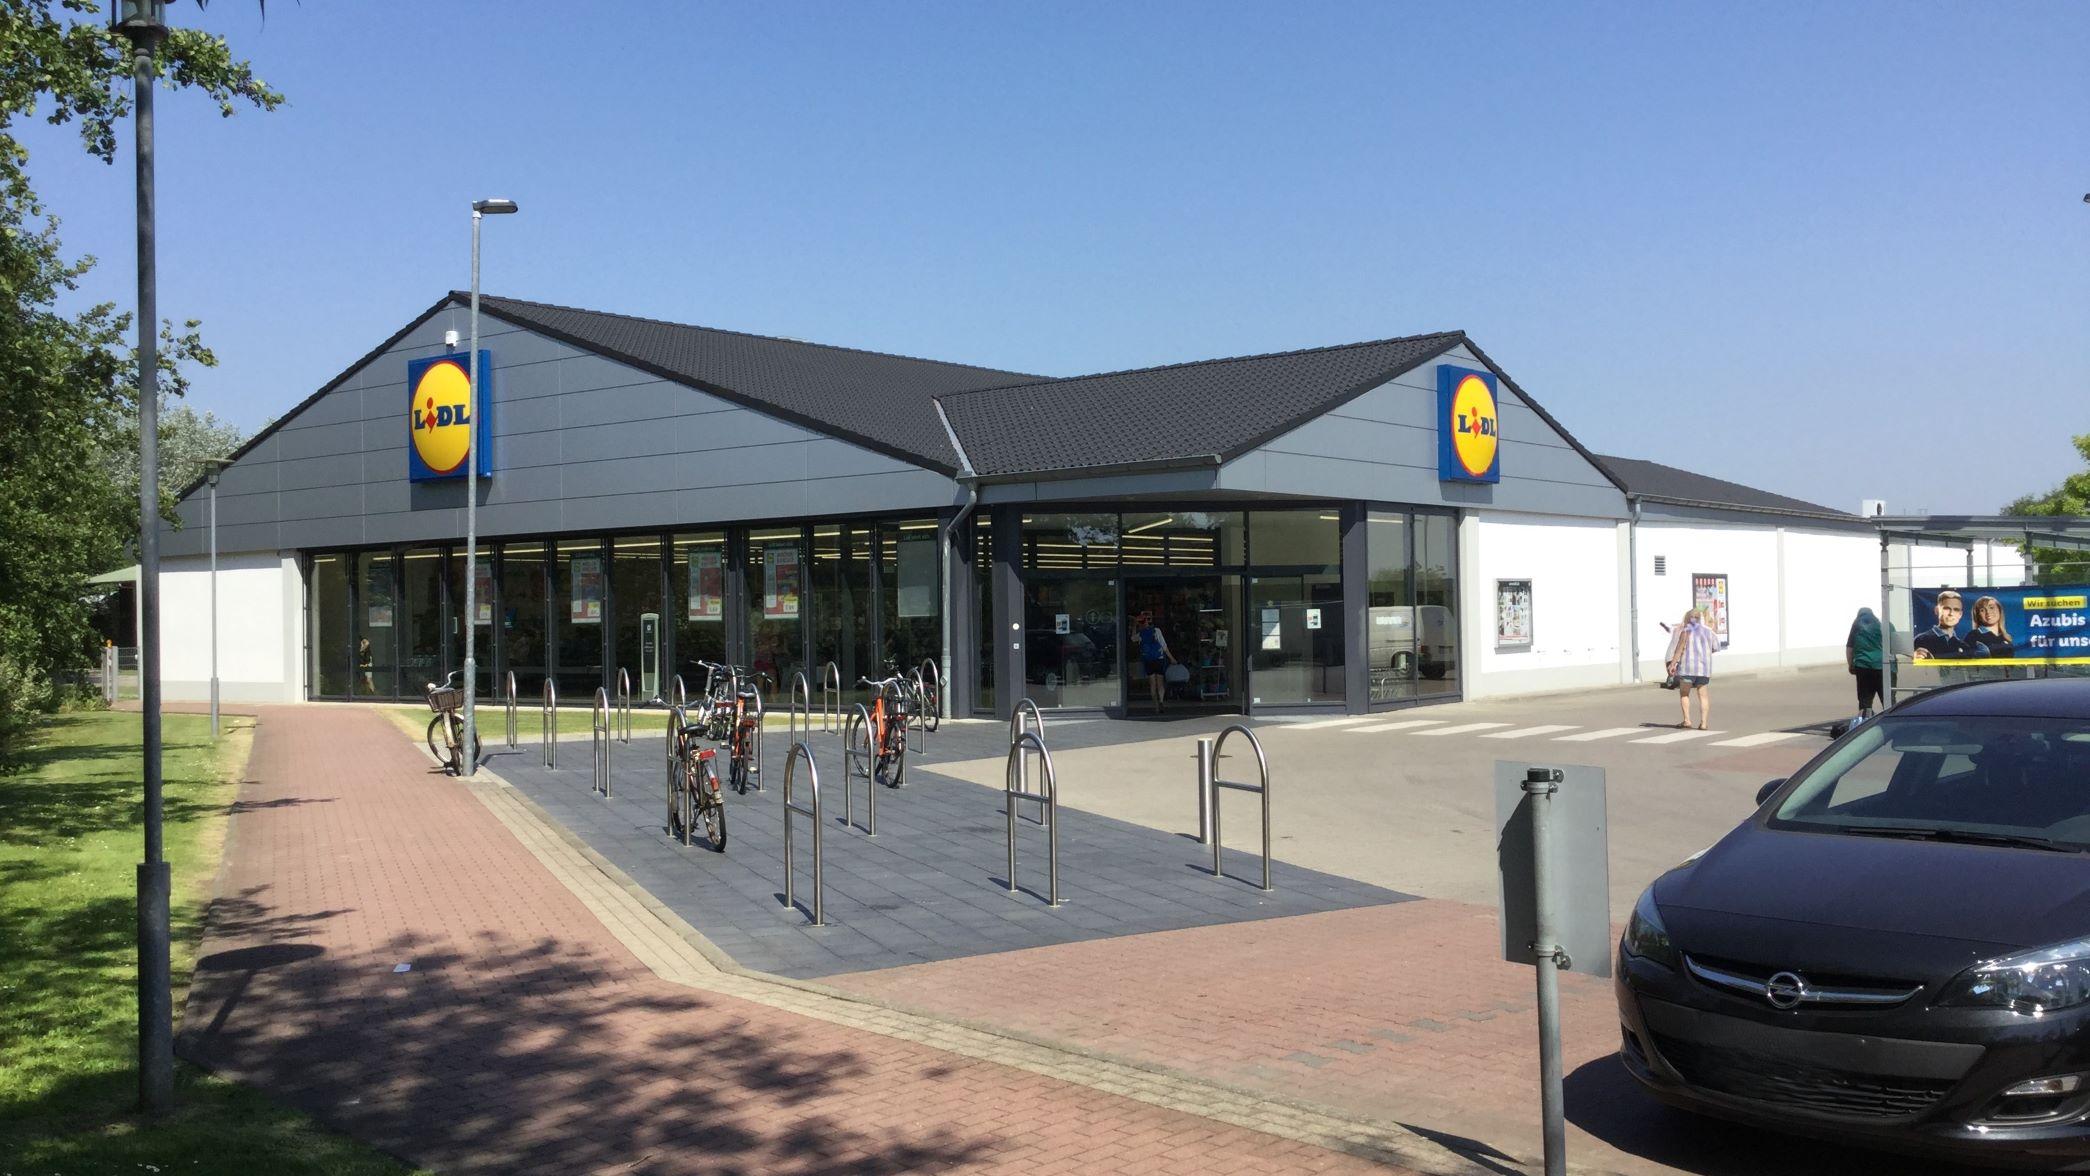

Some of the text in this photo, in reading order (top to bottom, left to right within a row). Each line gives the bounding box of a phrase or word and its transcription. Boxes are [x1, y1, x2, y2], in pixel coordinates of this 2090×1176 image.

[2046, 599, 2080, 607] suchen
[2030, 612, 2086, 627] Azubis
[2030, 635, 2055, 647] für
